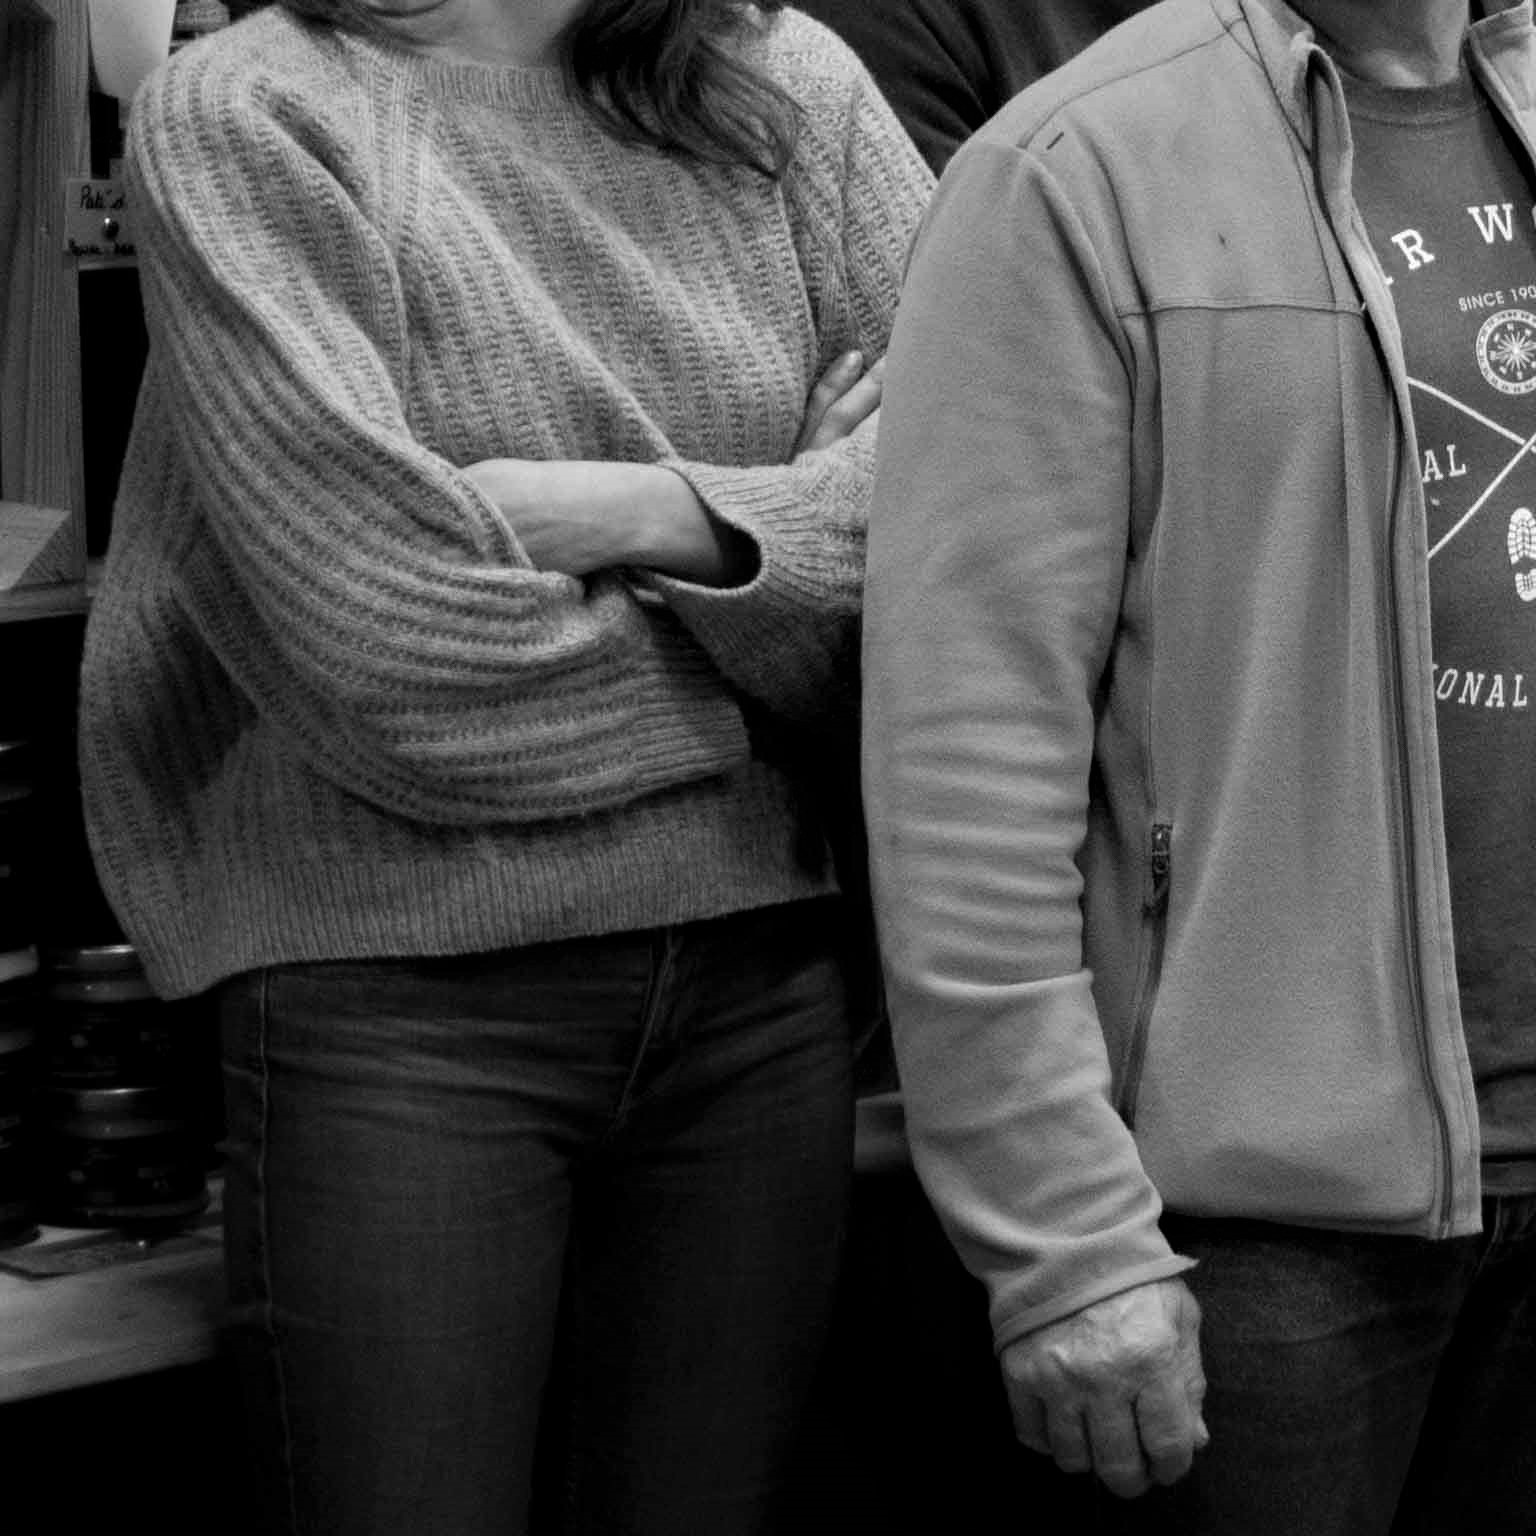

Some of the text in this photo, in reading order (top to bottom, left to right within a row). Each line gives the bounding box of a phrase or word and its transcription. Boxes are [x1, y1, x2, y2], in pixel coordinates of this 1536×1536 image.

[1383, 228, 1435, 286] R
[1457, 290, 1505, 313] SINCE
[1432, 663, 1528, 708] ONAL
